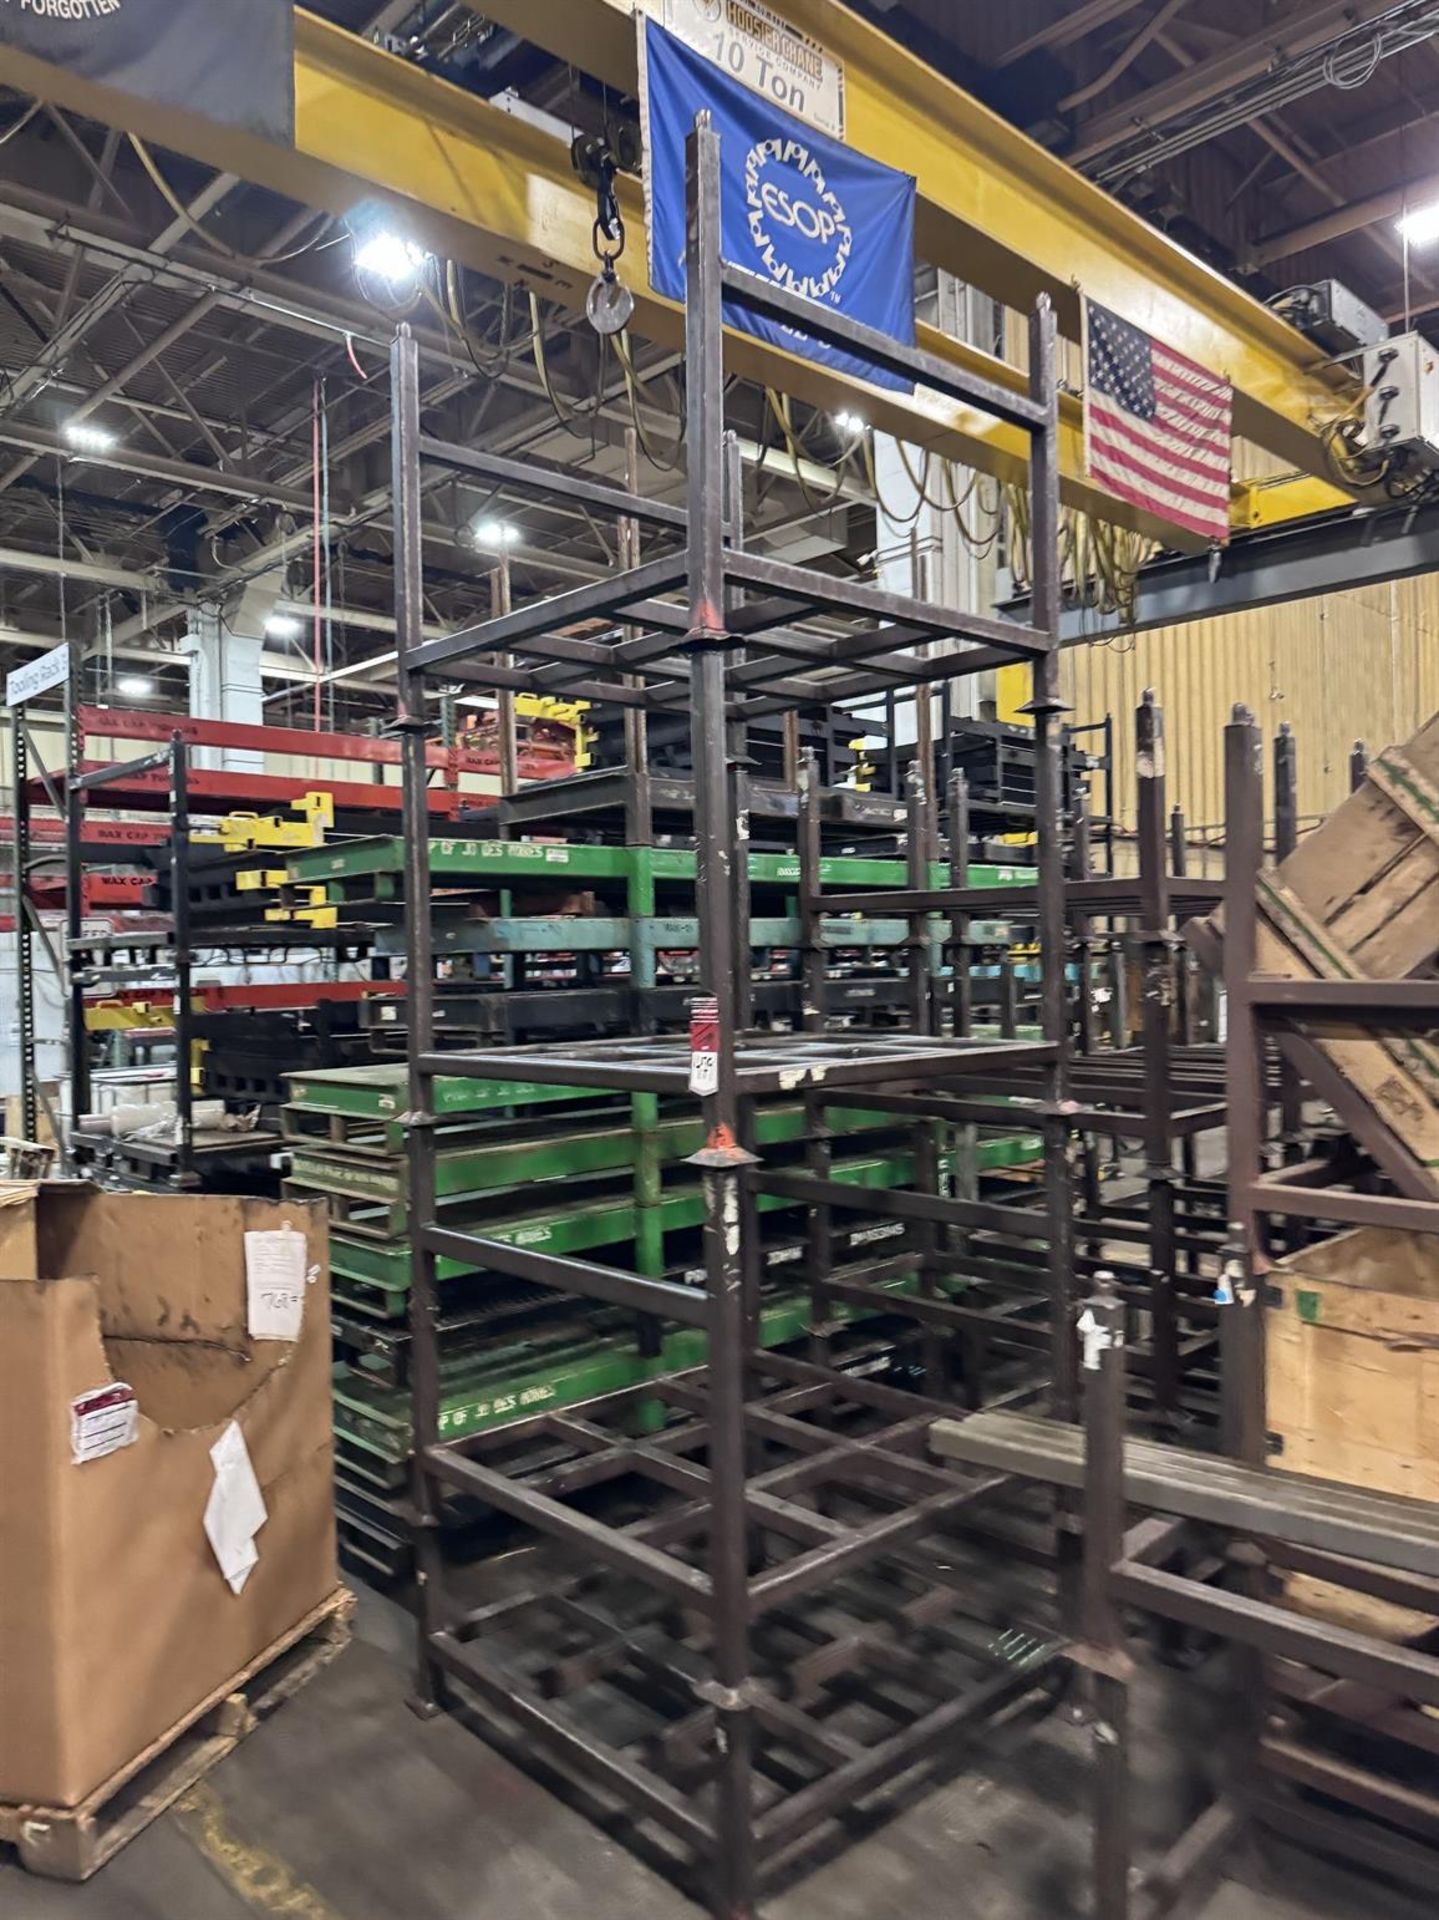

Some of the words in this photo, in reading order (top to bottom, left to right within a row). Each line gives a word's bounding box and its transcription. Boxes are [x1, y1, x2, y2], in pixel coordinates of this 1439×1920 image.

[726, 2, 781, 52] HOOSIER
[714, 31, 745, 74] 10
[756, 55, 805, 113] Ton
[761, 182, 836, 245] ESOP
